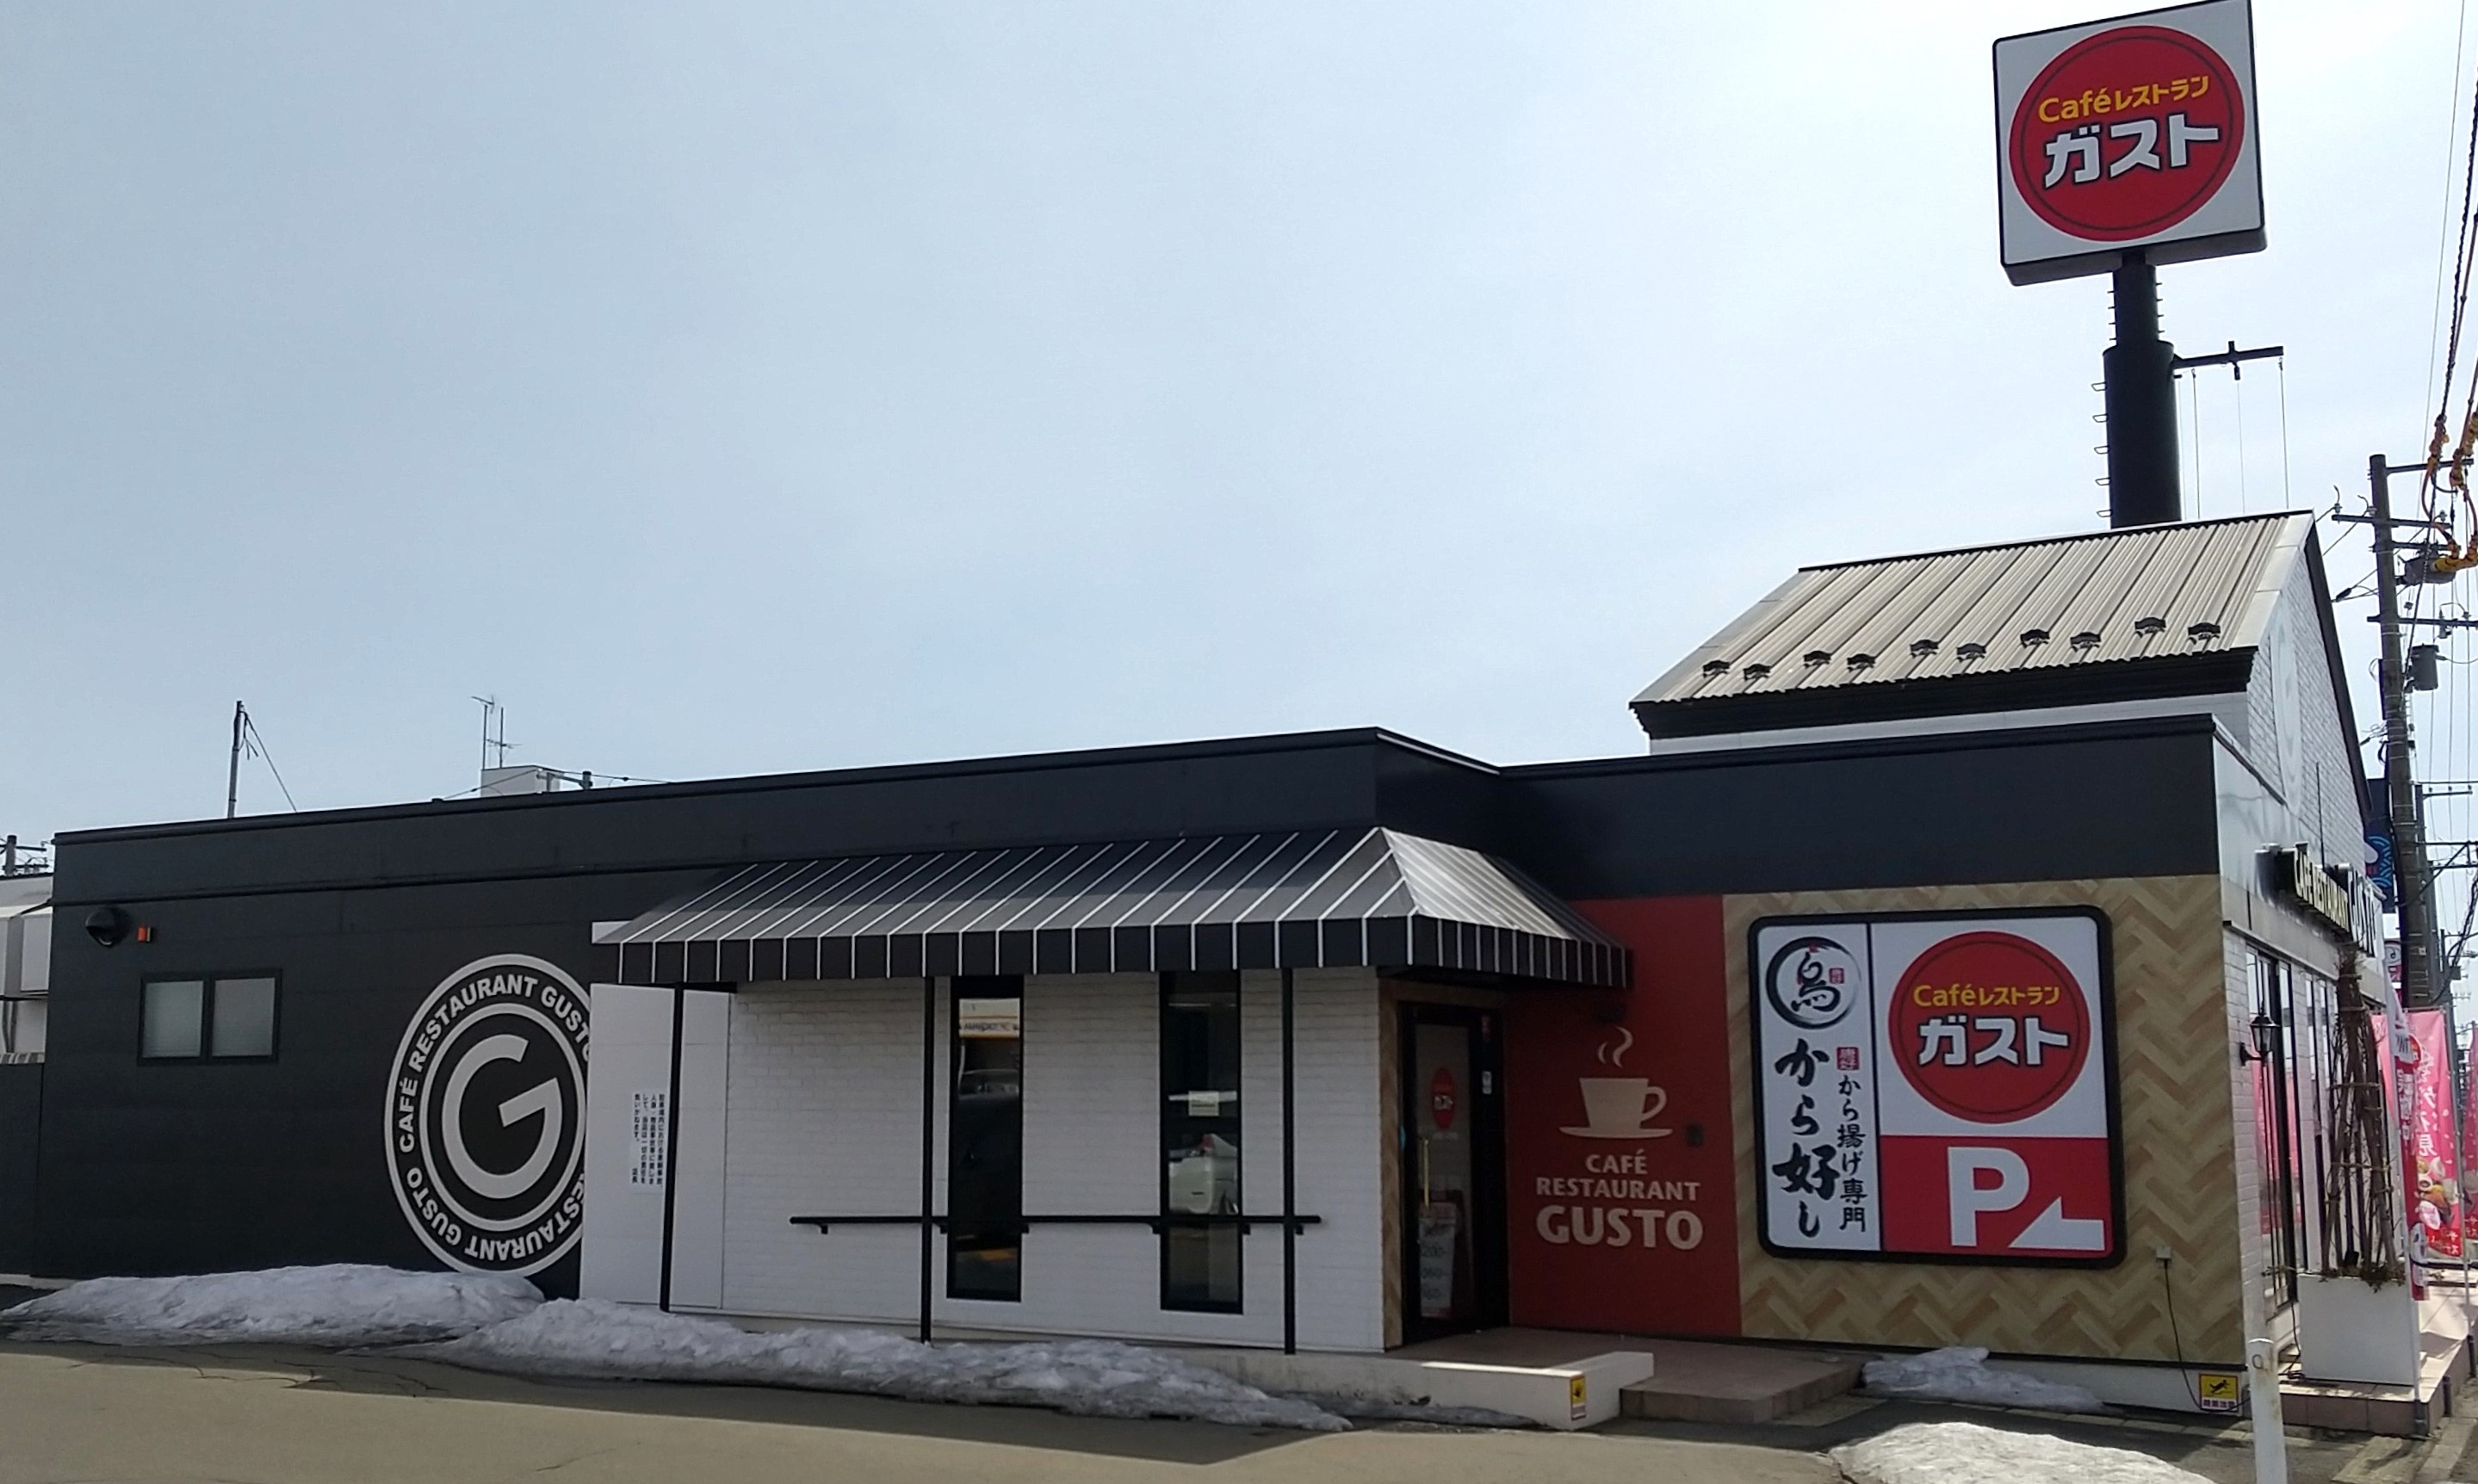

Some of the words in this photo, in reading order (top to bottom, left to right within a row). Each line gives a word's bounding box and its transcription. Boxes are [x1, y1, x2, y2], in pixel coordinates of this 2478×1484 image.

[2044, 113, 2220, 189] ガスト
[408, 974, 538, 1073] RESTAURANT
[1918, 1016, 2070, 1067] ガスト
[399, 1076, 418, 1153] CAFÉ
[442, 1034, 563, 1199] G
[1773, 1038, 1840, 1238] から好し
[1837, 1074, 1867, 1233] から揚げ専門
[1536, 1178, 1701, 1202] RESTAURANT
[1585, 1149, 1648, 1175] CAFÉ
[1948, 1146, 2030, 1247] P
[406, 1168, 463, 1246] GUSTO
[465, 1173, 584, 1261] ESTAURANT
[1536, 1205, 1704, 1251] GUSTO
